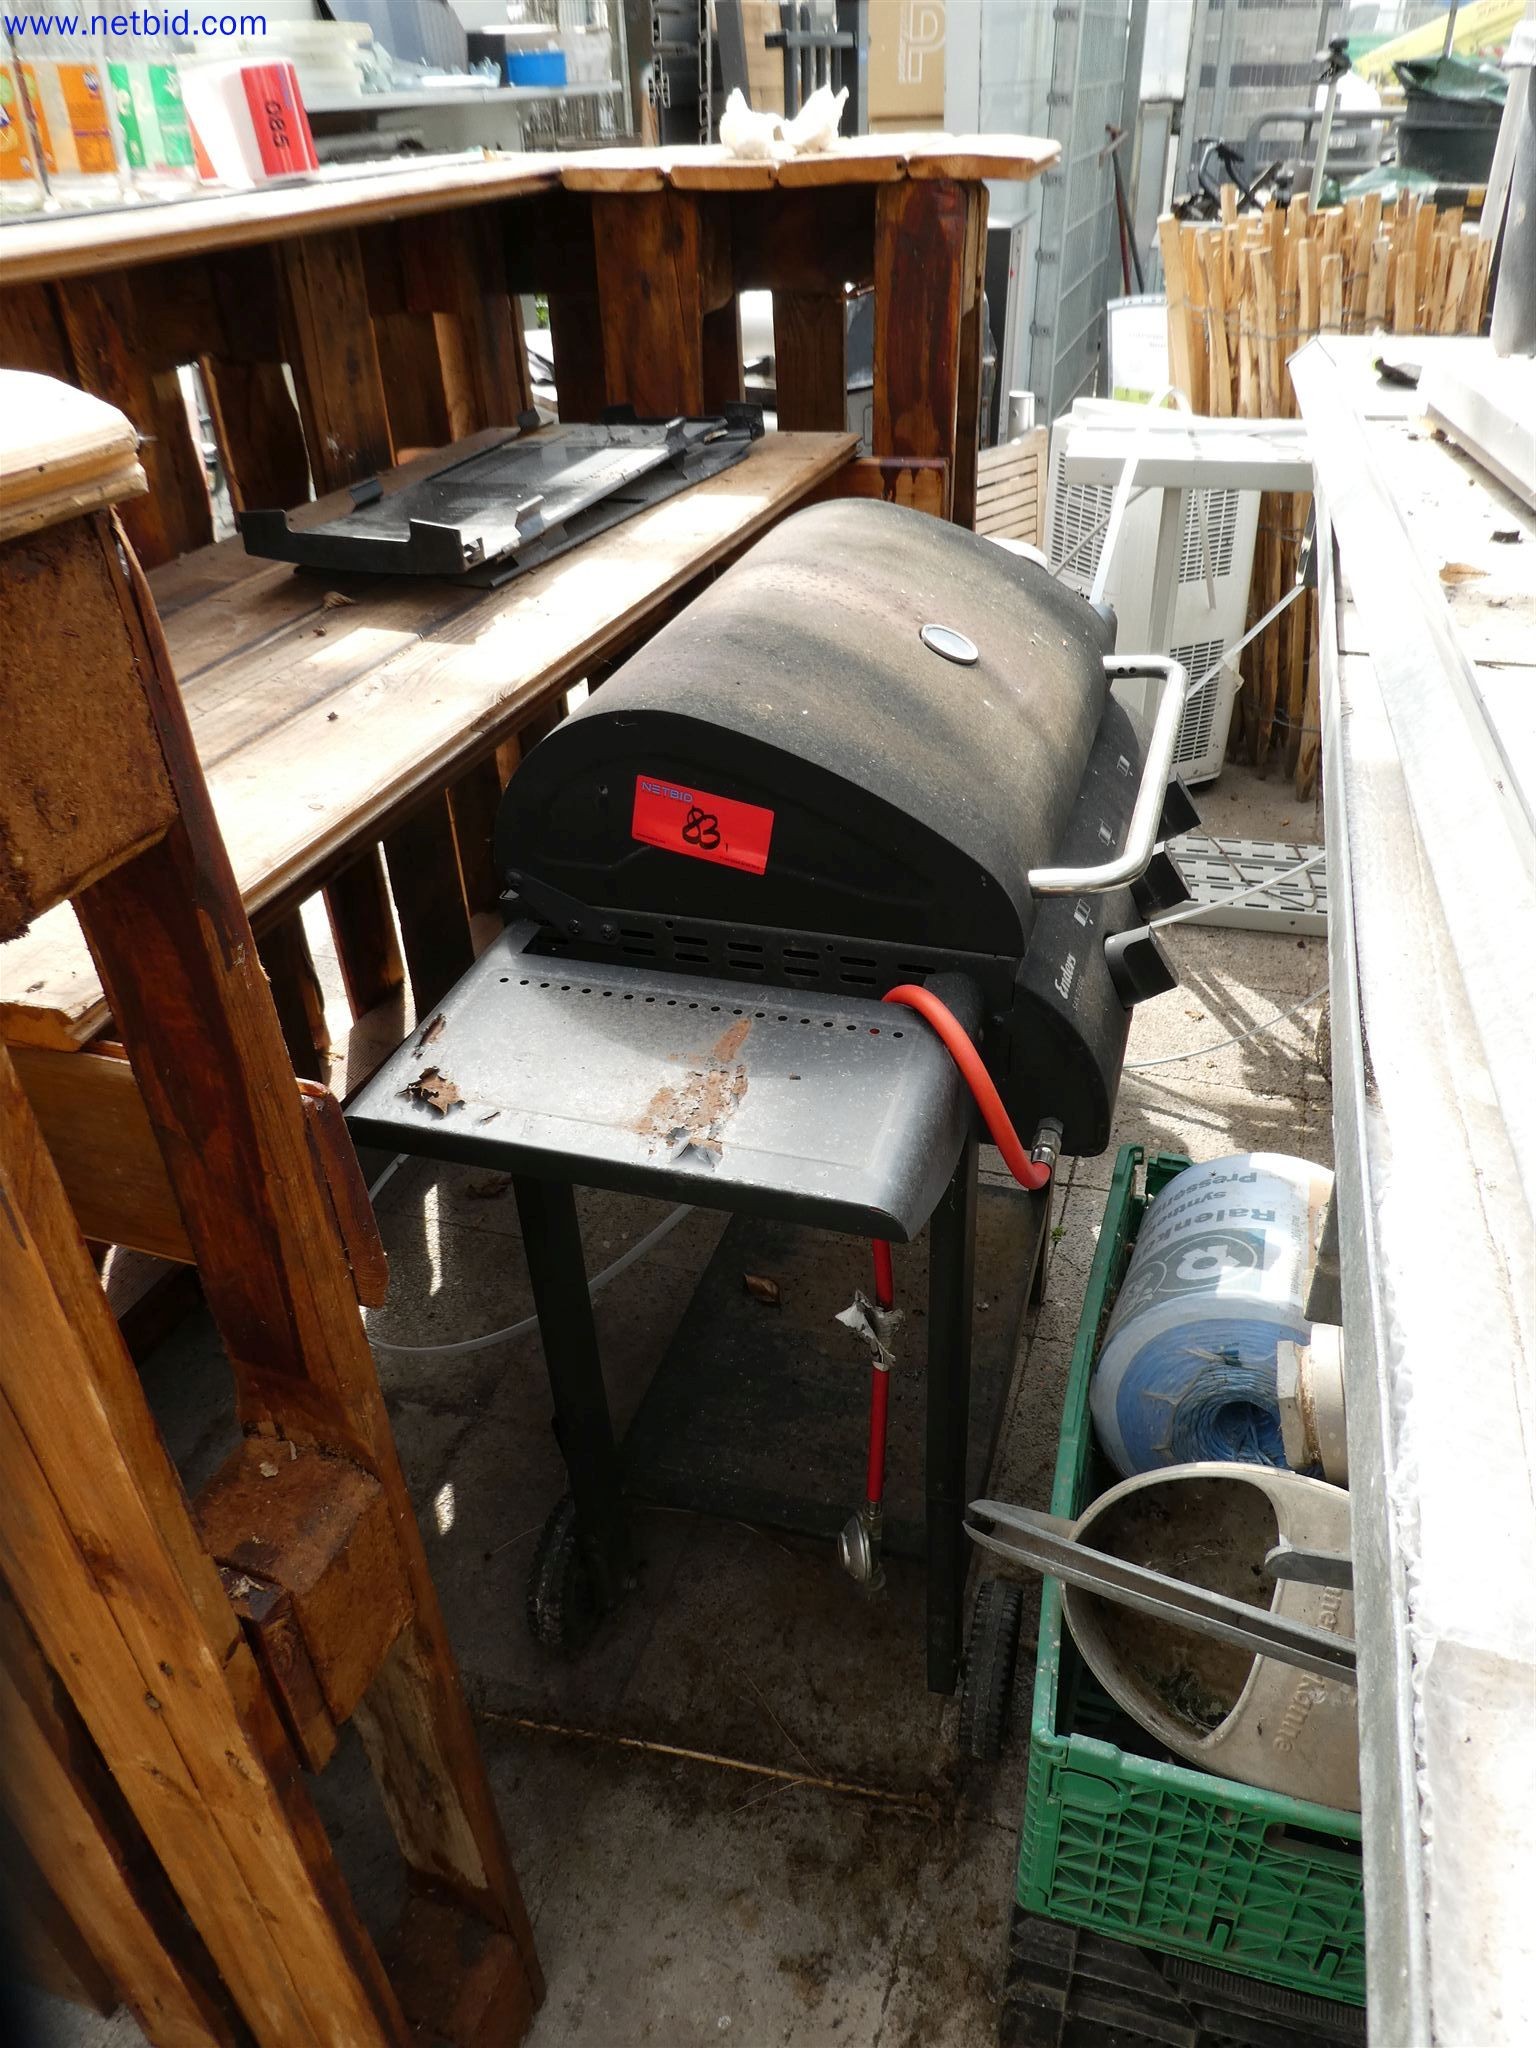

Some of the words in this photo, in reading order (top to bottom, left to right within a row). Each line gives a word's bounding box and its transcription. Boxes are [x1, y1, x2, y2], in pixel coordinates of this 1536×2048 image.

[641, 781, 693, 803] NETBID
[682, 805, 721, 850] 83
[1054, 952, 1077, 1000] Enders
